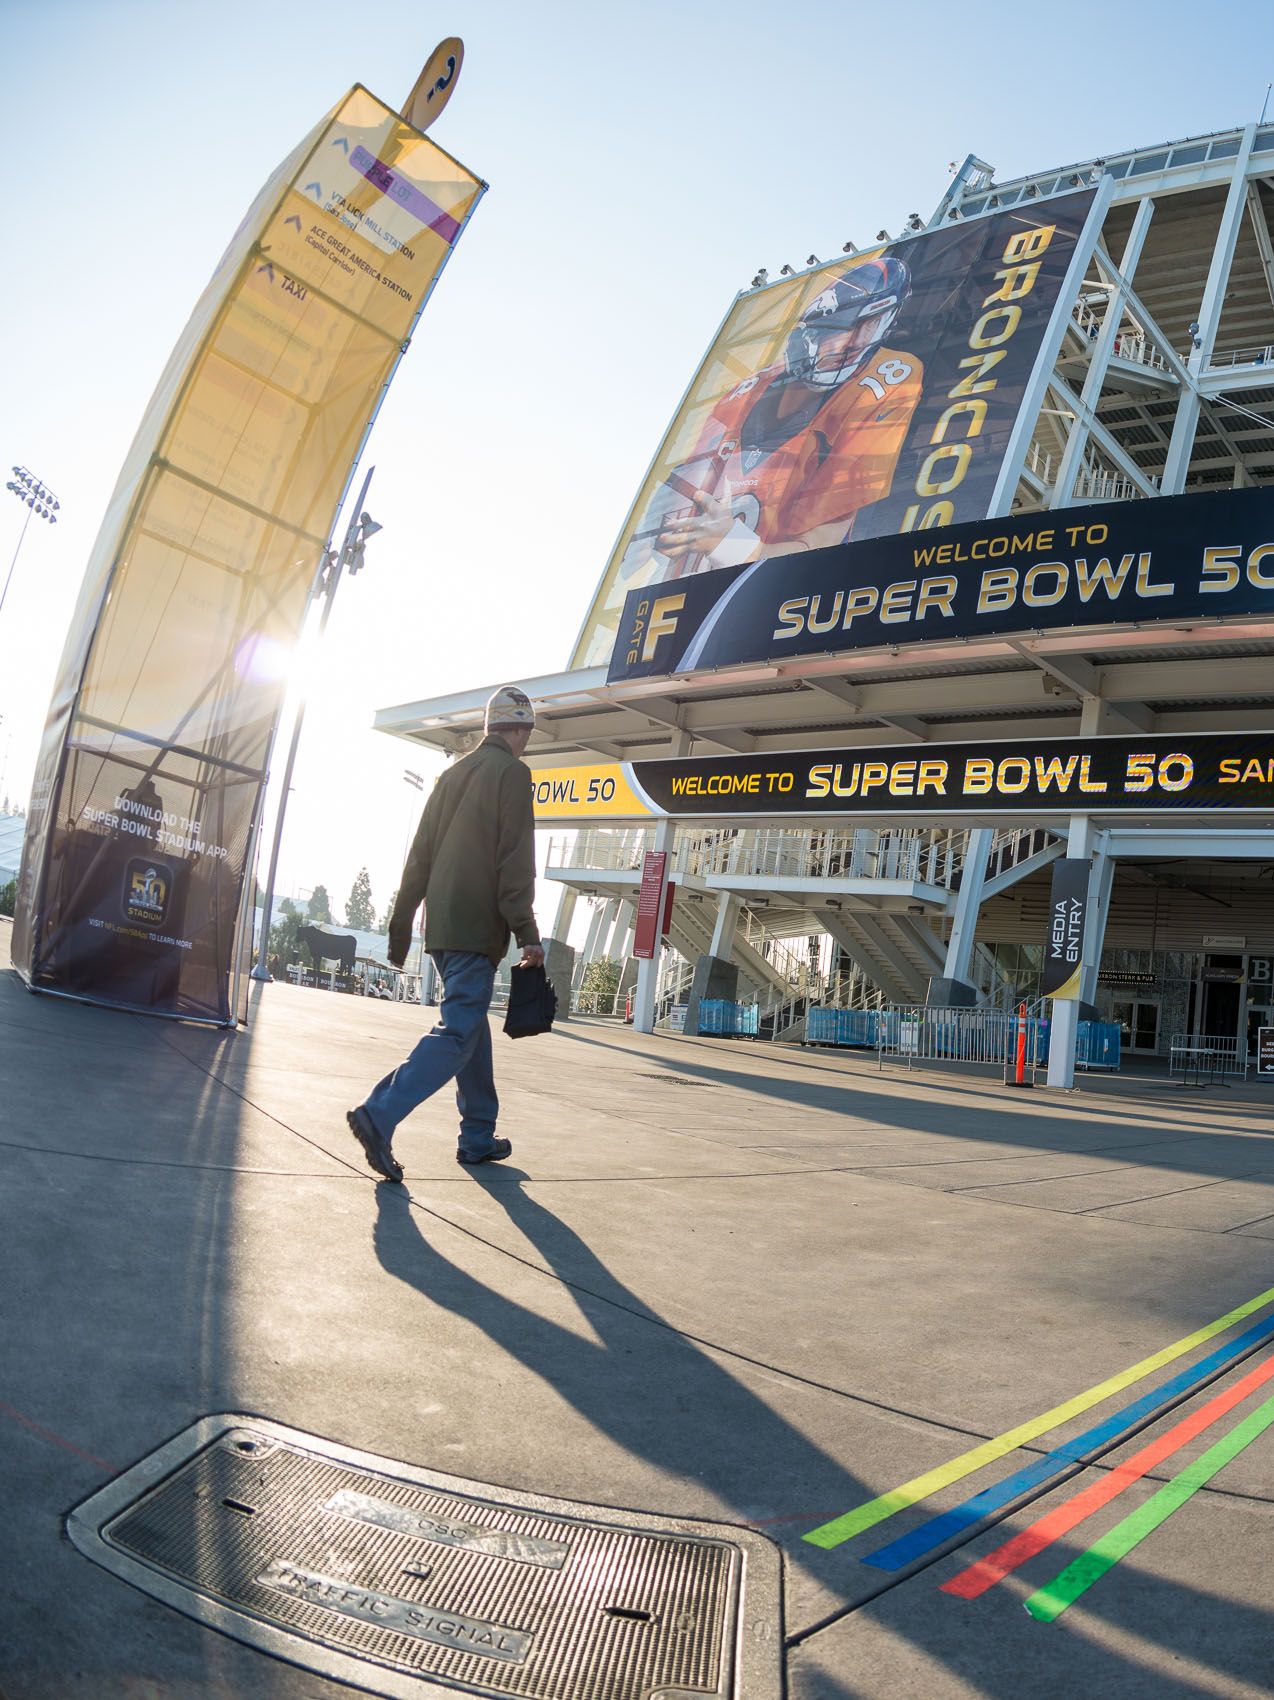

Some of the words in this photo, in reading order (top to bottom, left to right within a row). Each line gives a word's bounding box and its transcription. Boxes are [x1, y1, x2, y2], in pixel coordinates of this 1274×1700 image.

[352, 151, 395, 188] PURPLE
[391, 180, 412, 202] LOT
[331, 191, 347, 208] VTA
[346, 203, 365, 222] LICK
[364, 217, 383, 236] MILL
[383, 231, 415, 260] STATION
[280, 275, 307, 301] TAXI
[310, 225, 326, 241] ACE
[326, 234, 352, 258] GREAT
[349, 251, 382, 281] AMERICA
[381, 277, 413, 302] STATION
[913, 531, 1054, 568] WELCOME
[1066, 524, 1108, 548] TO
[773, 576, 957, 640] SUPER
[977, 552, 1175, 616] BOWL
[626, 601, 649, 664] GATE
[642, 594, 685, 663] F
[587, 777, 616, 802] 50
[672, 774, 761, 795] WELCOME
[765, 772, 794, 792] TO
[806, 760, 947, 799] SUPER
[962, 754, 1107, 795] BOWL
[1123, 753, 1194, 793] 50
[83, 807, 119, 829] SUPER
[121, 819, 153, 840] BOWL
[156, 830, 205, 854] STADIUM
[206, 845, 229, 859] APP
[113, 796, 177, 826] DOWNLOAD
[179, 817, 202, 834] THE
[128, 907, 162, 921] STADIUM
[1051, 900, 1067, 958] MEDIA
[1066, 897, 1082, 962] ENTRY
[276, 1567, 390, 1617] TRAFFIC
[404, 1610, 513, 1653] SIGNAL
